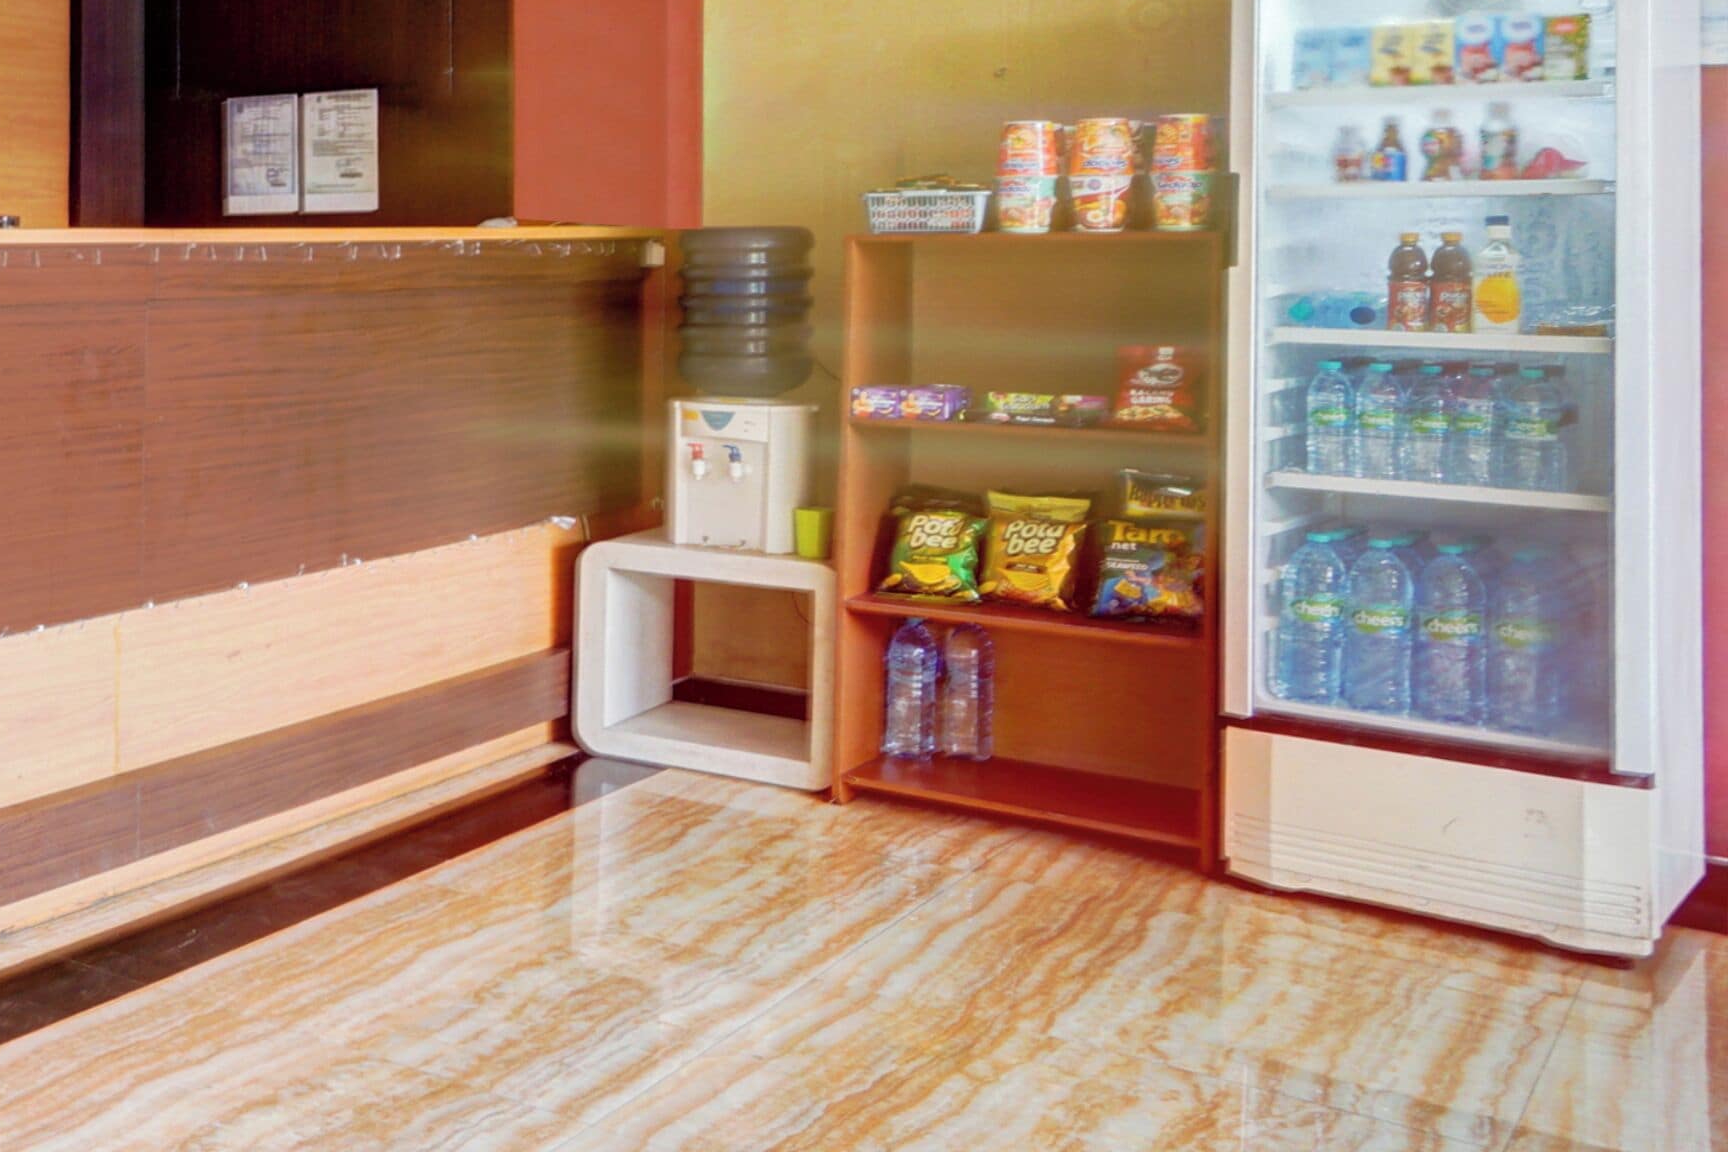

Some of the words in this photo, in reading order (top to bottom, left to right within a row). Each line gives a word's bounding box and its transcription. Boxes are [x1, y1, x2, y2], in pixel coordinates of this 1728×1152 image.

[907, 514, 964, 537] Pota
[1003, 519, 1065, 540] Pota
[1107, 519, 1186, 545] Taro
[909, 532, 958, 549] bee
[1007, 534, 1058, 556] bee
[1111, 541, 1137, 551] net
[1354, 610, 1404, 626] cheers
[1427, 617, 1478, 634] cheers
